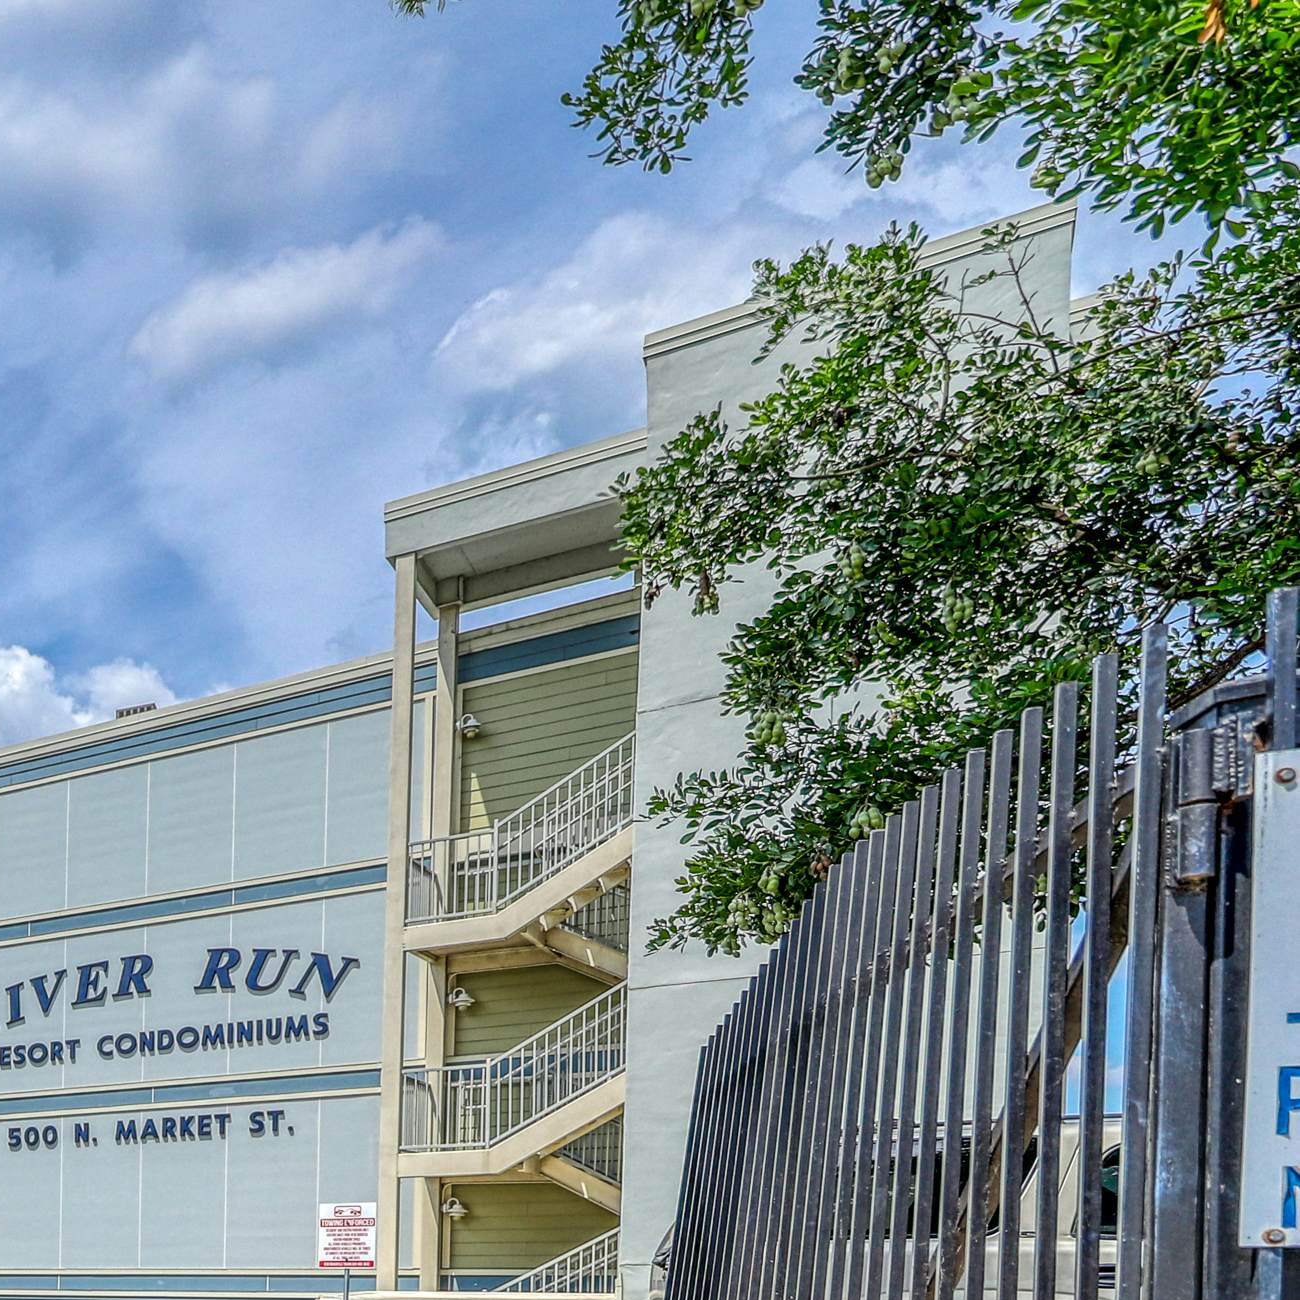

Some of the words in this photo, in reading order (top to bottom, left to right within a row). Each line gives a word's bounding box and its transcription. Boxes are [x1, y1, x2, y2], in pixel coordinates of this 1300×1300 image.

[194, 947, 359, 1003] RUN
[97, 1012, 330, 1059] CONDOMINIUMS
[7, 1124, 58, 1151] 500
[74, 1122, 98, 1147] N.
[115, 1113, 231, 1145] MARKET
[248, 1110, 295, 1138] ST.
[321, 1219, 343, 1227] TOWING
[344, 1218, 375, 1227] ENFORCED
